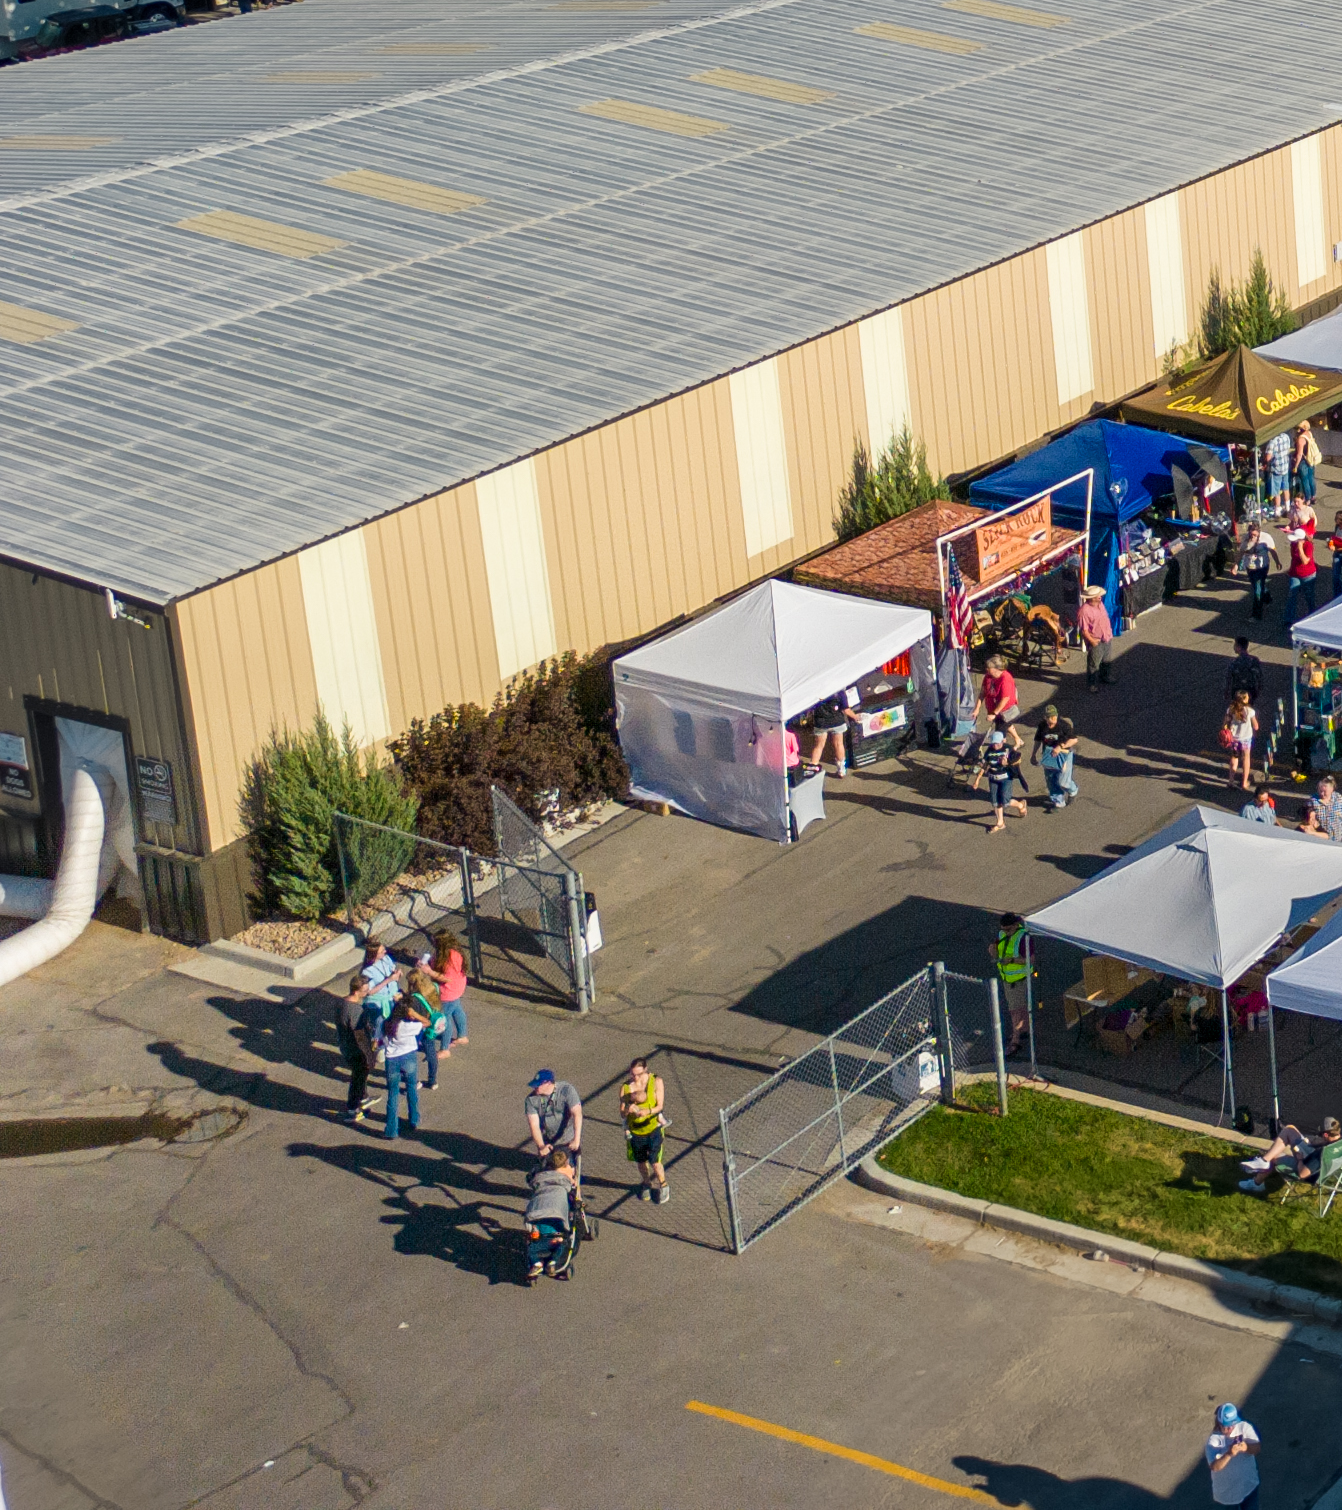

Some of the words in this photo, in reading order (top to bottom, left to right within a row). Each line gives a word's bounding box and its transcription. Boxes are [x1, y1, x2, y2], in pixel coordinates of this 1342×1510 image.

[1166, 394, 1241, 421] Cabela's
[1256, 384, 1321, 416] Cabela's
[8, 767, 19, 777] NO
[139, 765, 154, 776] NO
